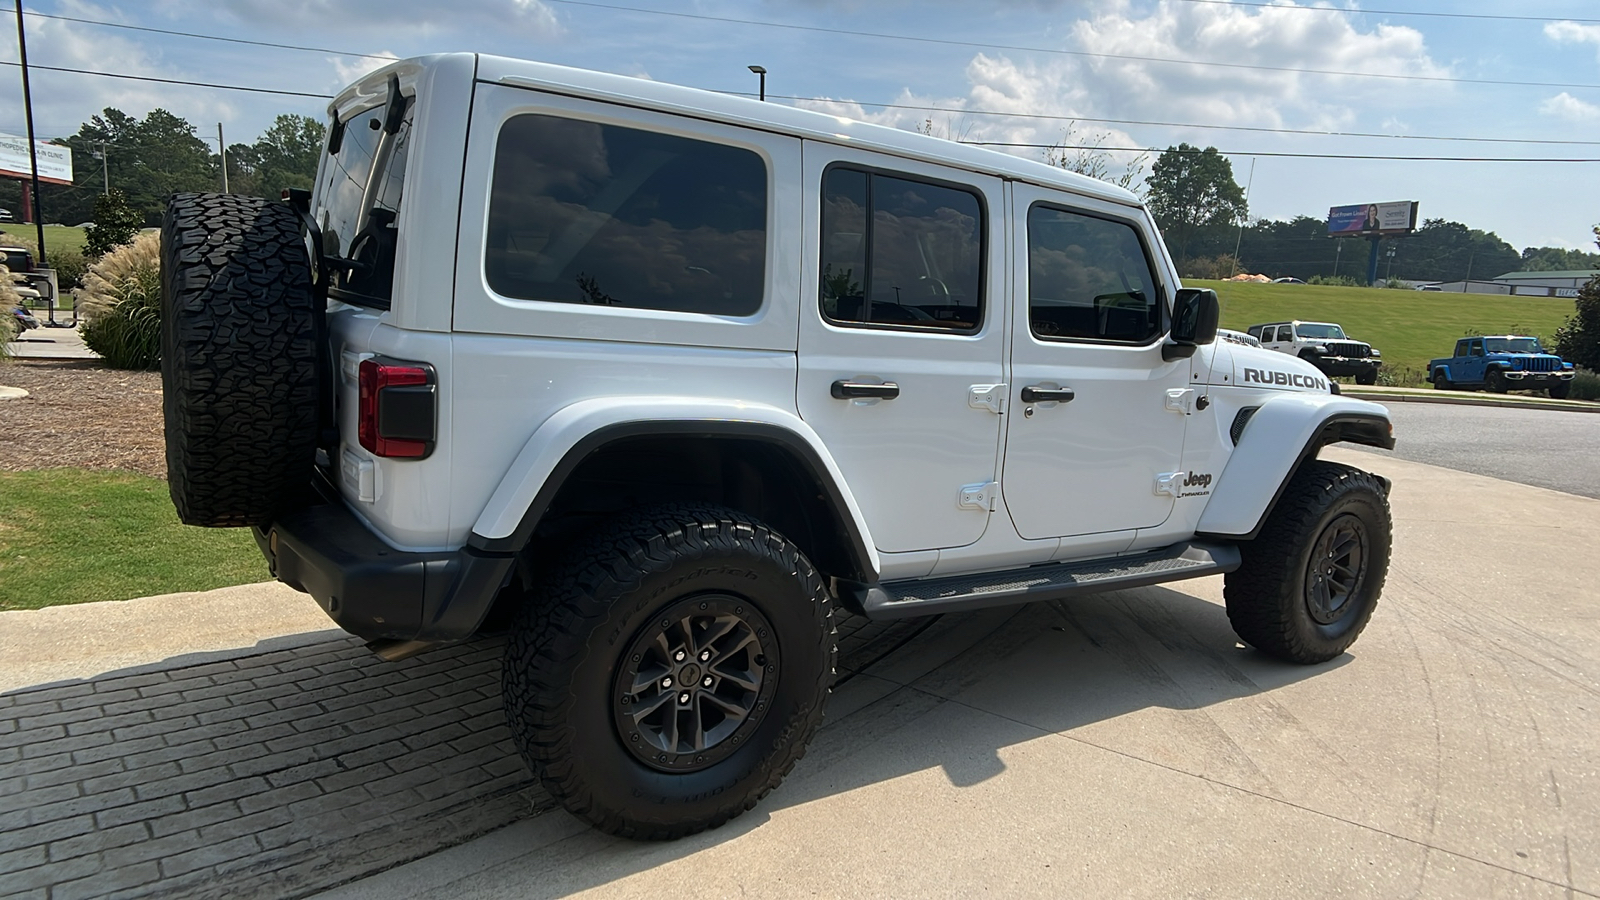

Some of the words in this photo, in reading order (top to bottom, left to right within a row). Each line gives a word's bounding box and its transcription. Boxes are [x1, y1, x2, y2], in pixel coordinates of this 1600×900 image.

[48, 151, 63, 160] CLINIC
[1244, 367, 1327, 390] RUBICON
[1183, 470, 1212, 488] Jeep
